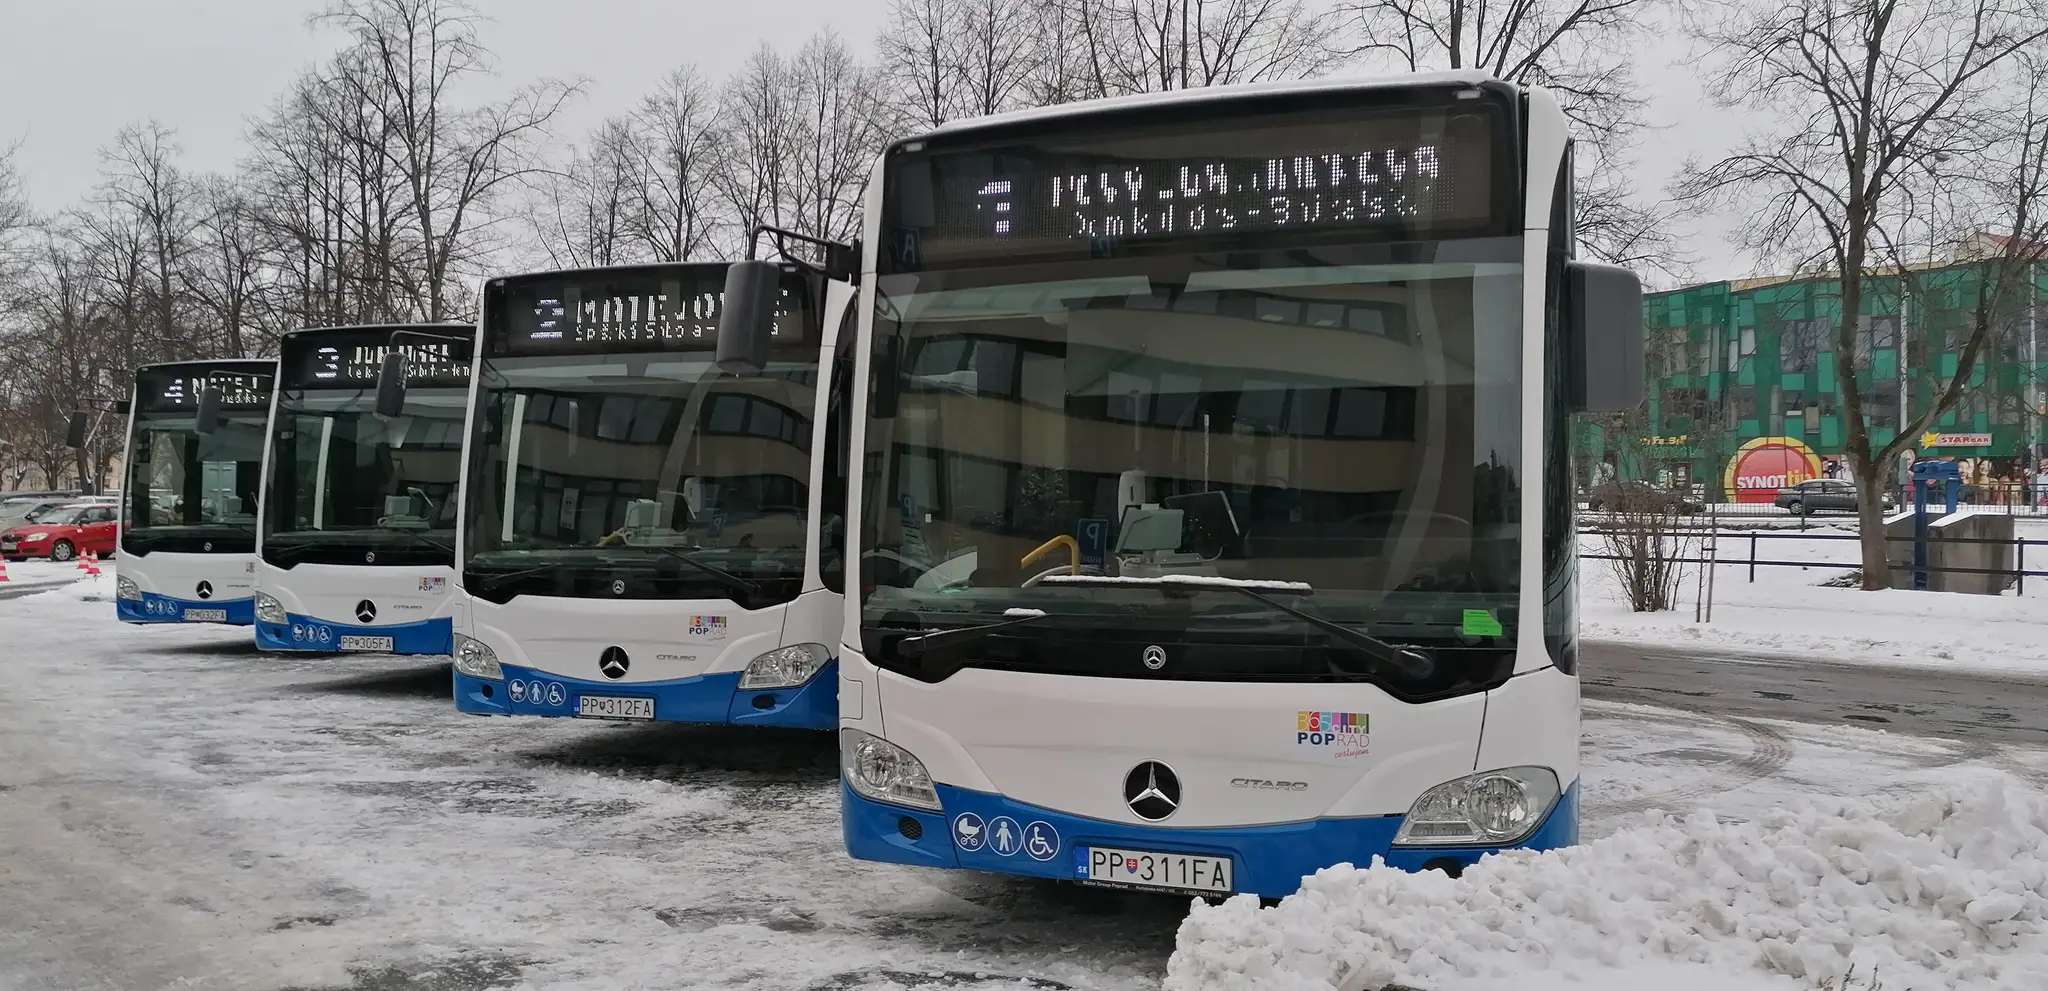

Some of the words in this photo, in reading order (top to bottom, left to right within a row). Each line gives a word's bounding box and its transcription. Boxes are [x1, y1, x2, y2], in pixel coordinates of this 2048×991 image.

[314, 347, 340, 379] 3
[1737, 475, 1787, 489] SYNOT
[1297, 732, 1370, 748] POPRAD
[1230, 778, 1308, 791] CITARO
[1077, 865, 1088, 874] SK
